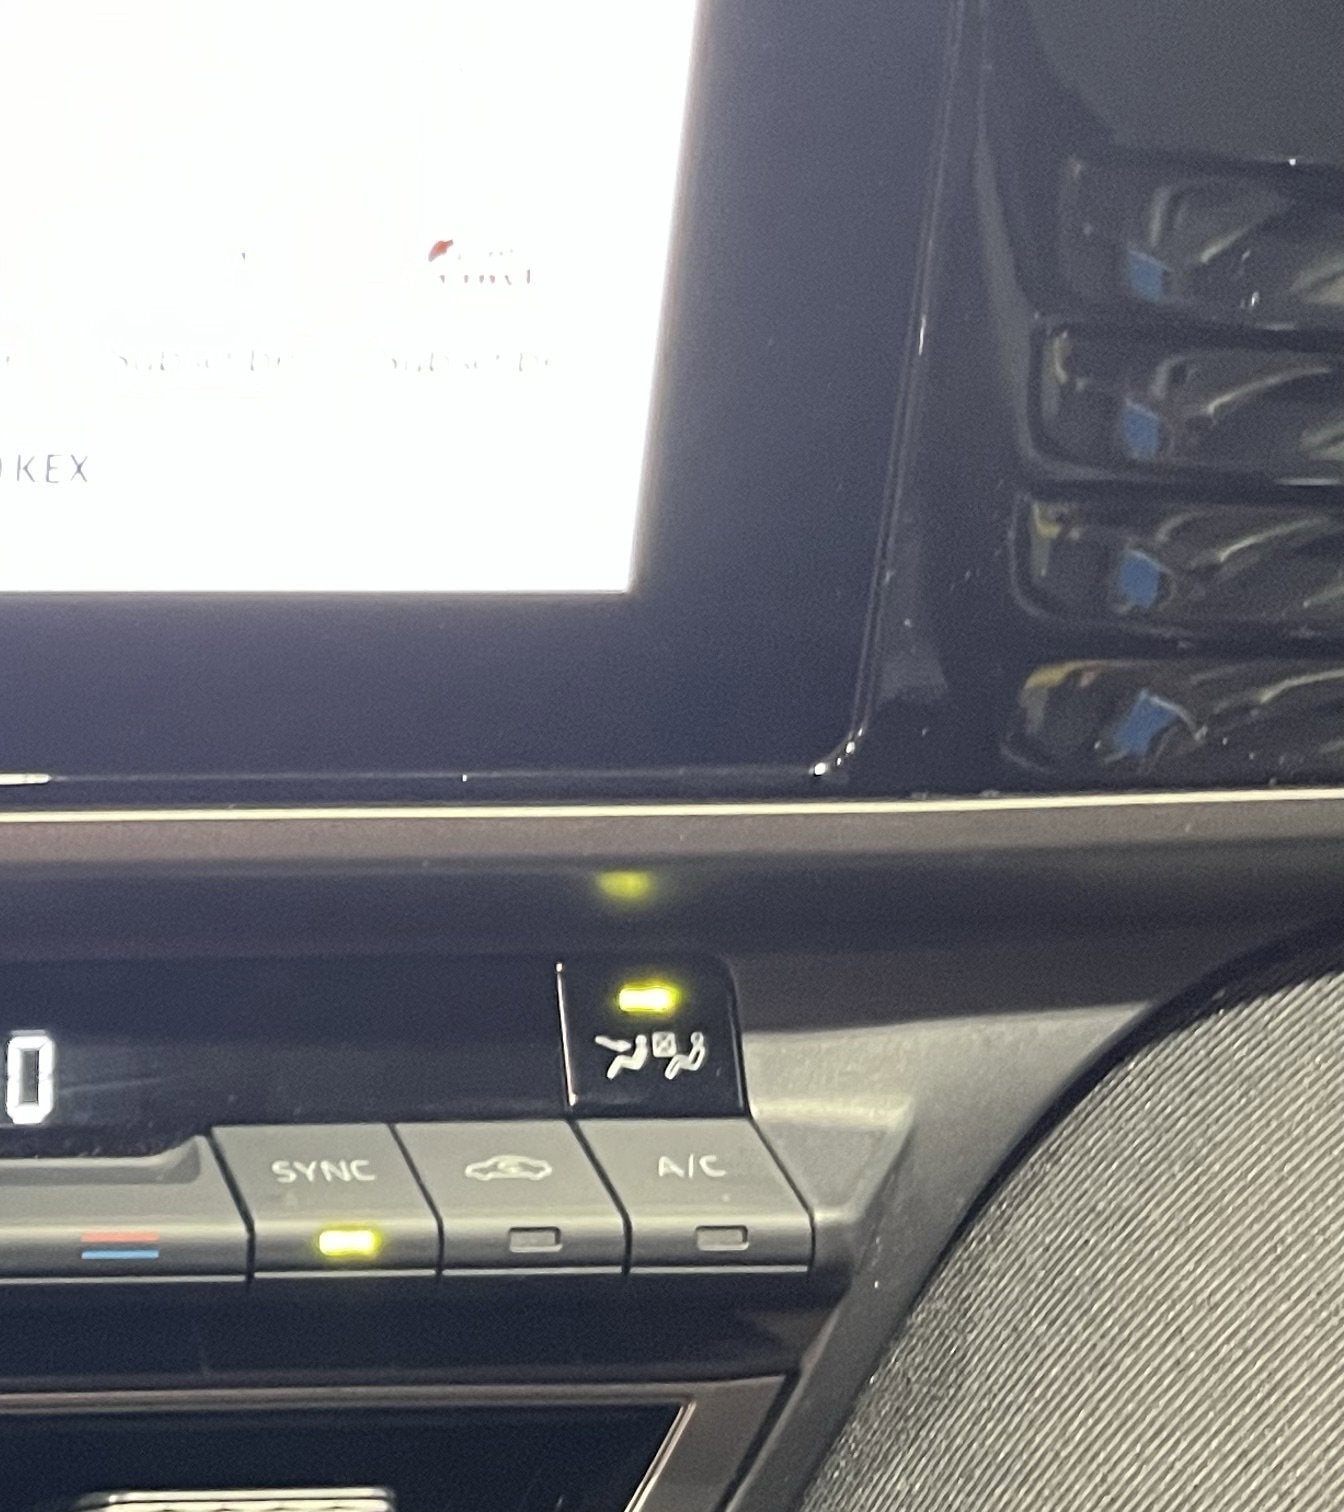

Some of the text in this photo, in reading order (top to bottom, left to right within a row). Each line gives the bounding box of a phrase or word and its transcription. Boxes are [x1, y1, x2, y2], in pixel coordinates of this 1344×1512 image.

[14, 452, 90, 485] KEX
[270, 1158, 377, 1184] SYNC
[657, 1154, 728, 1179] A/C
